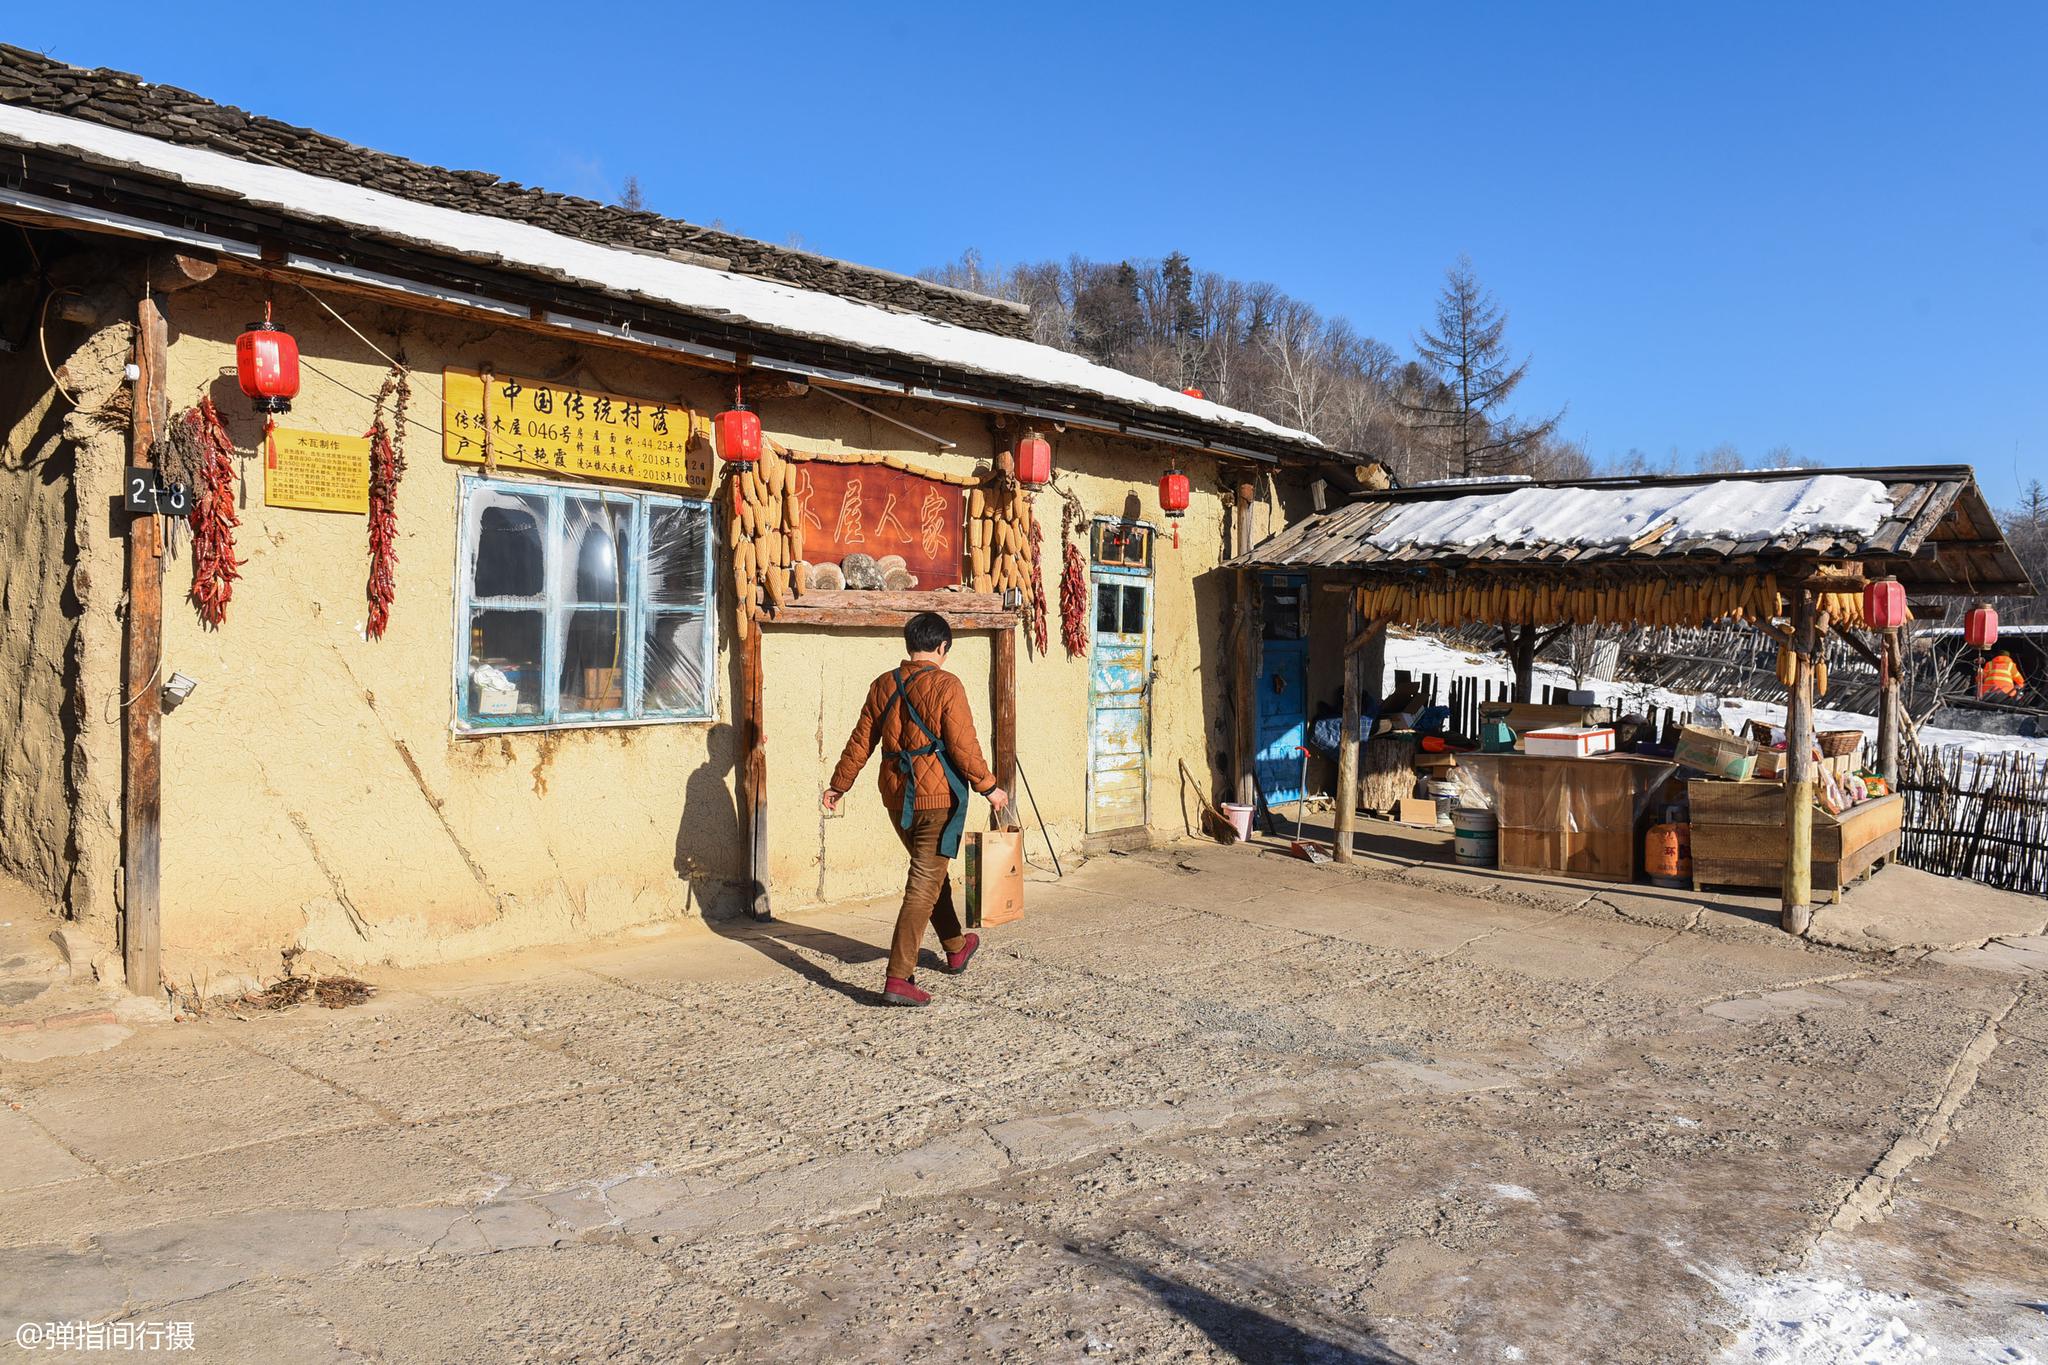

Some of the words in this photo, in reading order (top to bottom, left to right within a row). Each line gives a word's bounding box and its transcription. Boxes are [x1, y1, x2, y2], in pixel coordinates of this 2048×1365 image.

[501, 378, 670, 435] 中国传统村落
[297, 437, 341, 450] 木瓦制作
